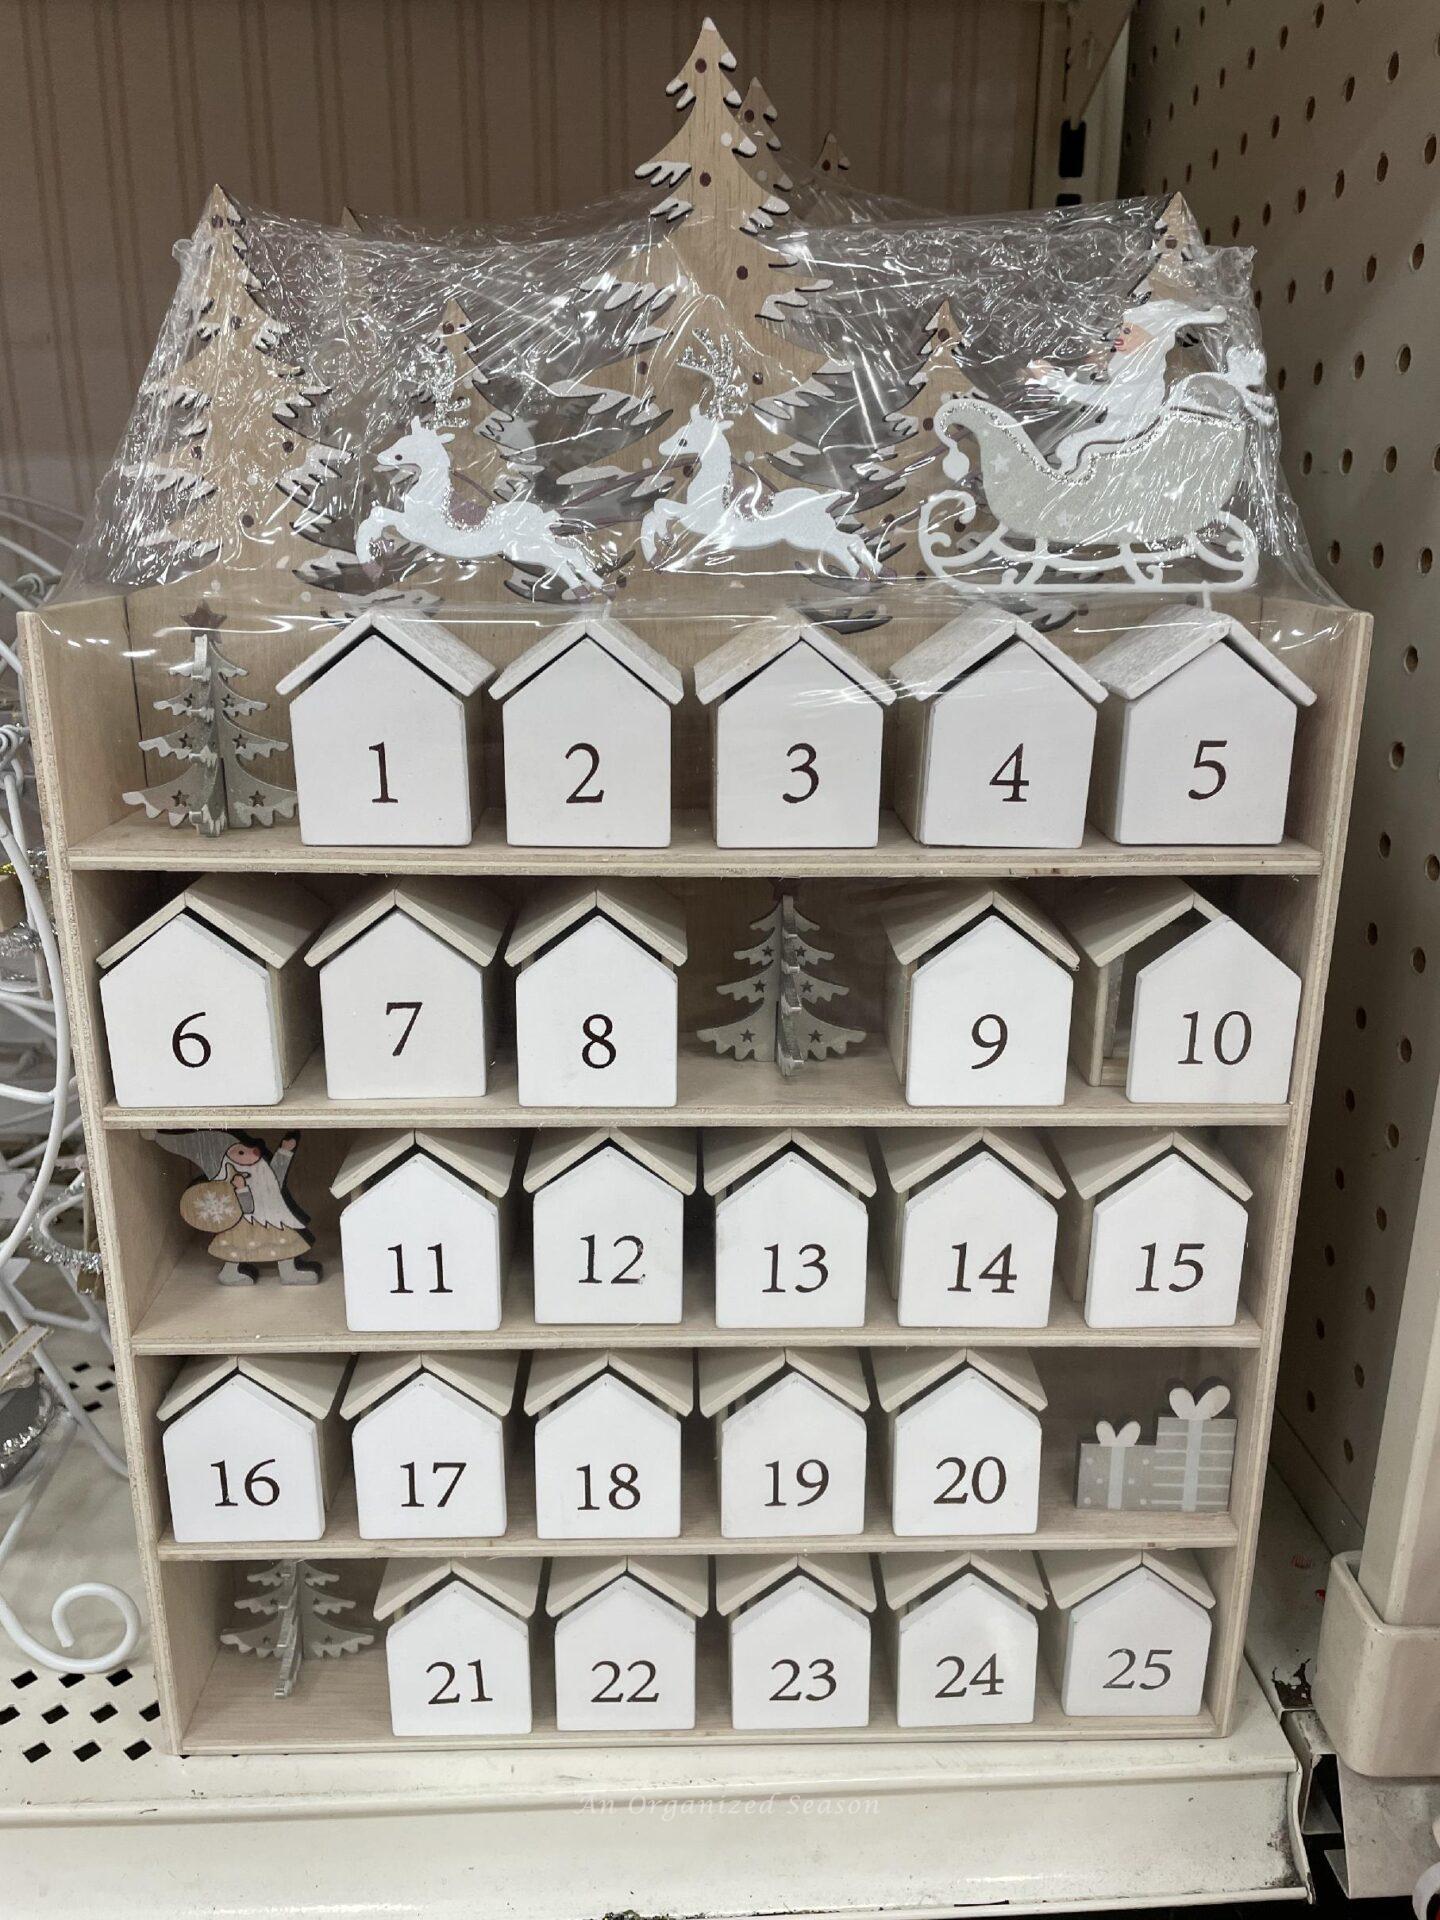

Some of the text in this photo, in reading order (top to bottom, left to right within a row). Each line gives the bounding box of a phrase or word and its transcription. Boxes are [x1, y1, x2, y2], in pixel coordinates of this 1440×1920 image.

[368, 741, 399, 804] 1
[564, 742, 605, 804] 2
[782, 742, 820, 804] 3
[988, 742, 1030, 803] 4
[1188, 739, 1228, 801] 5
[171, 1011, 212, 1069] 6
[385, 1001, 424, 1057] 7
[581, 1013, 617, 1070] 8
[971, 1013, 1009, 1070] 9
[1177, 1010, 1252, 1066] 10
[387, 1242, 454, 1294] 11
[578, 1233, 644, 1285] 12
[761, 1243, 829, 1294] 13
[946, 1241, 1018, 1294] 14
[1135, 1242, 1206, 1293] 15
[210, 1458, 281, 1507] 16
[399, 1461, 468, 1508] 17
[575, 1462, 641, 1511] 18
[764, 1458, 830, 1507] 19
[933, 1455, 1007, 1505] 20
[425, 1658, 494, 1705] 21
[590, 1659, 660, 1703] 22
[768, 1658, 837, 1702] 23
[934, 1653, 1005, 1699] 24
[1102, 1648, 1173, 1691] 25
